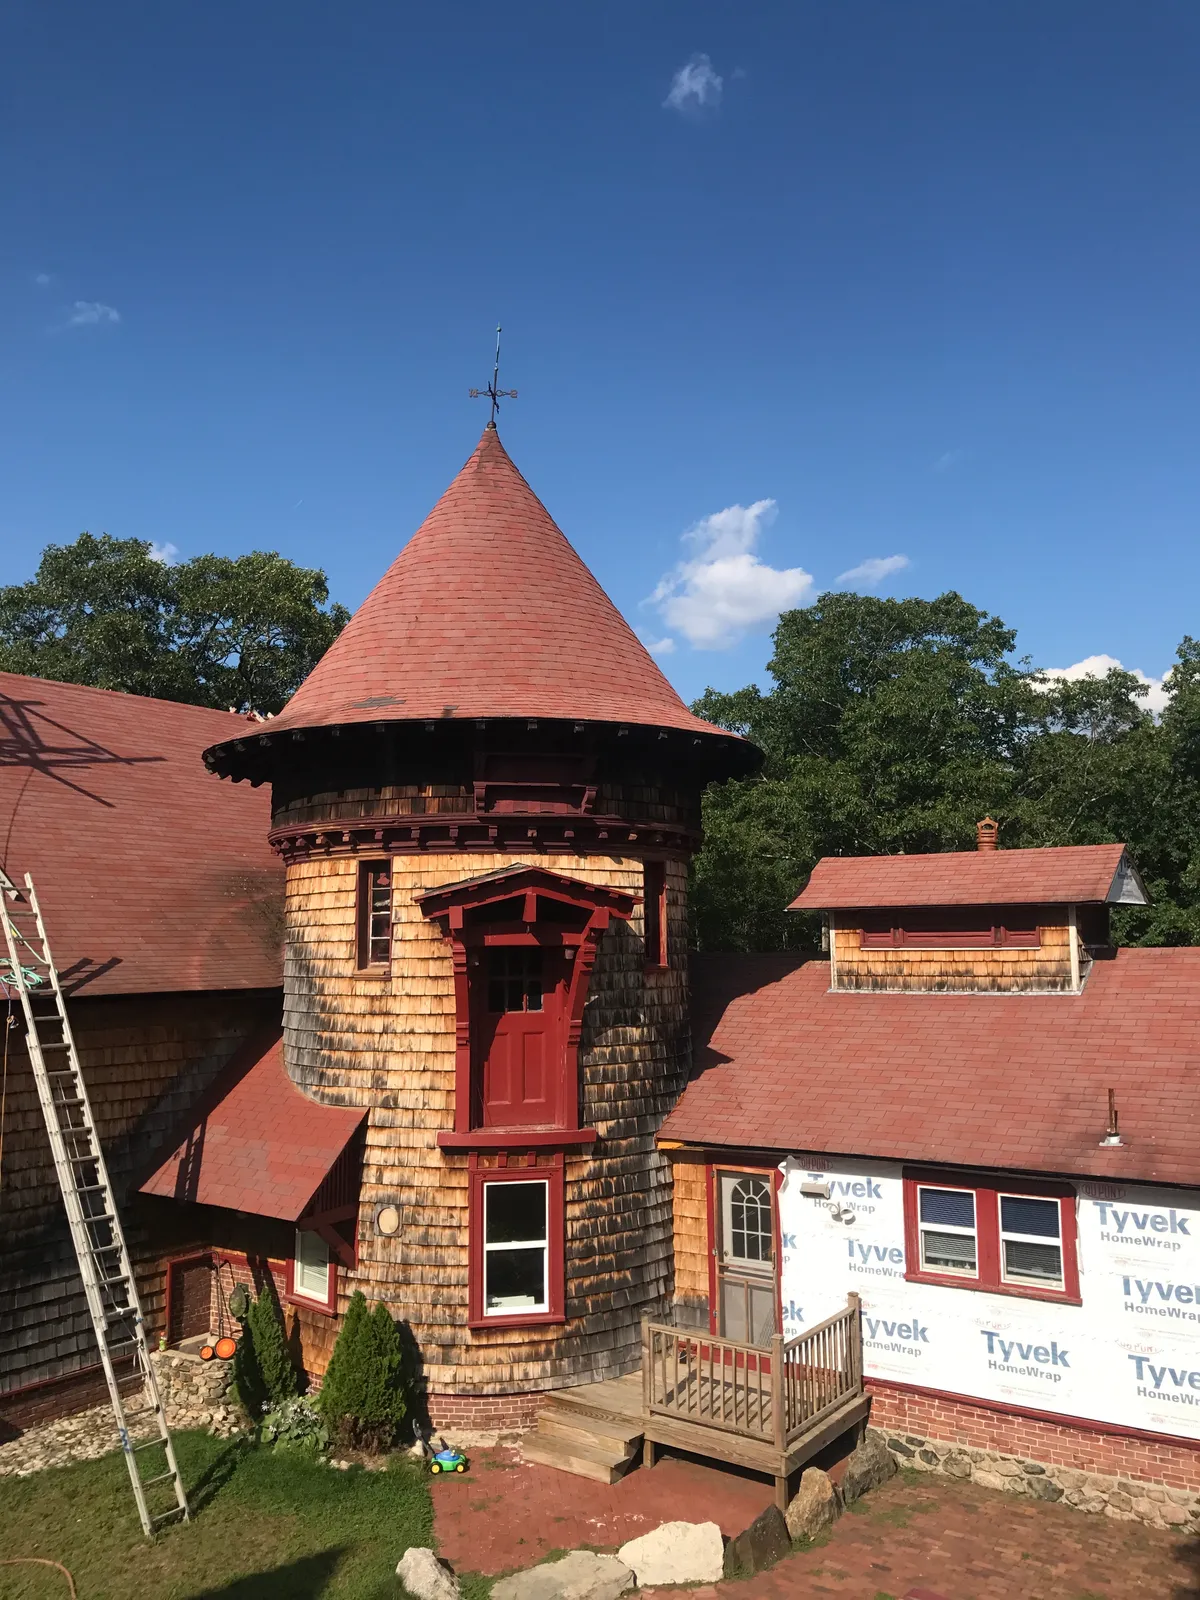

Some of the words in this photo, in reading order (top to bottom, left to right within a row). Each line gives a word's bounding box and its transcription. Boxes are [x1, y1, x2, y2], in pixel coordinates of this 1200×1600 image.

[814, 1198, 876, 1214] HoWrap
[1092, 1201, 1191, 1236] Tyvek
[1100, 1231, 1181, 1252] HomeWrap
[980, 1329, 1071, 1368] Tyvek
[988, 1359, 1062, 1383] HomeWrap
